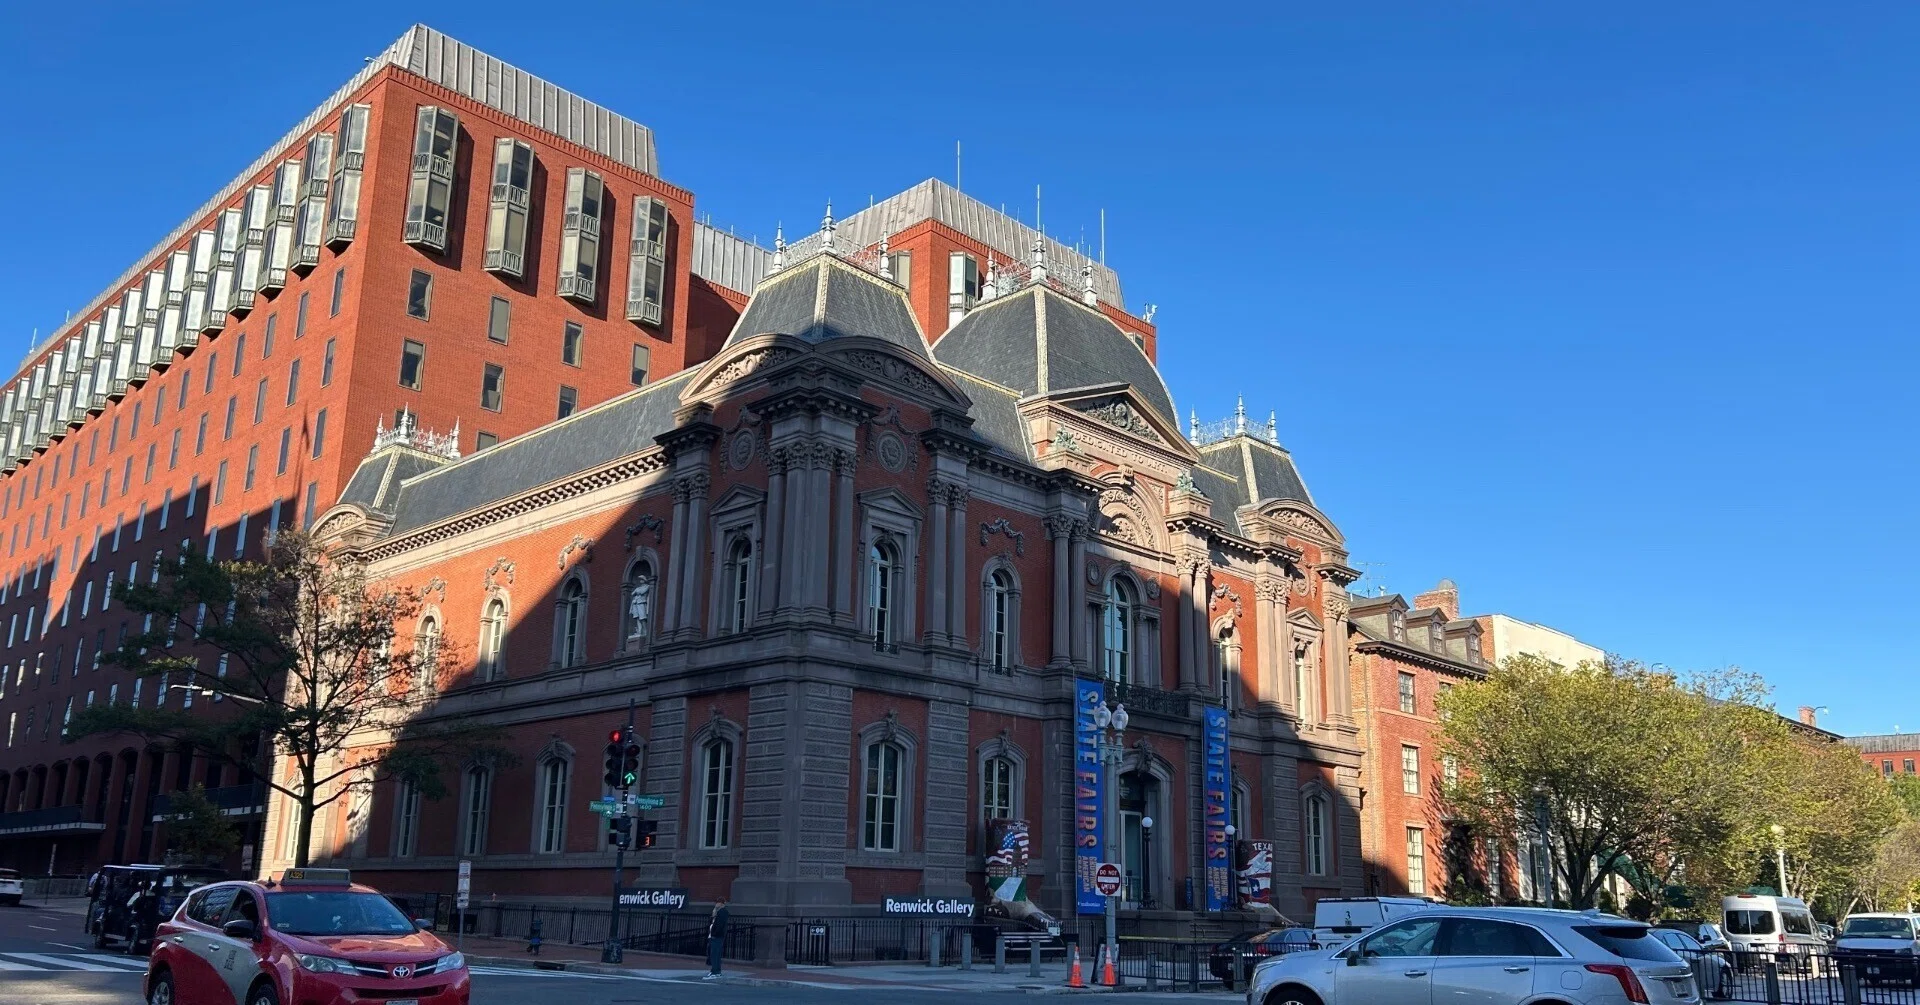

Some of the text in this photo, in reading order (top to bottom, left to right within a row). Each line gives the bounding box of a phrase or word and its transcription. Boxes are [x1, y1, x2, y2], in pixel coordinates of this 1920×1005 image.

[1074, 432, 1127, 458] DEDICATED
[1132, 453, 1144, 464] TO
[1078, 689, 1099, 849] STATE FAIRS
[1208, 716, 1227, 860] STATE FAIRS
[644, 836, 650, 846] 3
[1252, 842, 1273, 852] TEXA
[1082, 855, 1091, 893] AMERICAN
[1212, 866, 1221, 900] AMERICAN
[1220, 866, 1228, 897] GROWING
[619, 890, 685, 909] enwick Gallery
[886, 898, 975, 917] Renwick Gallery
[1345, 910, 1351, 920] 3
